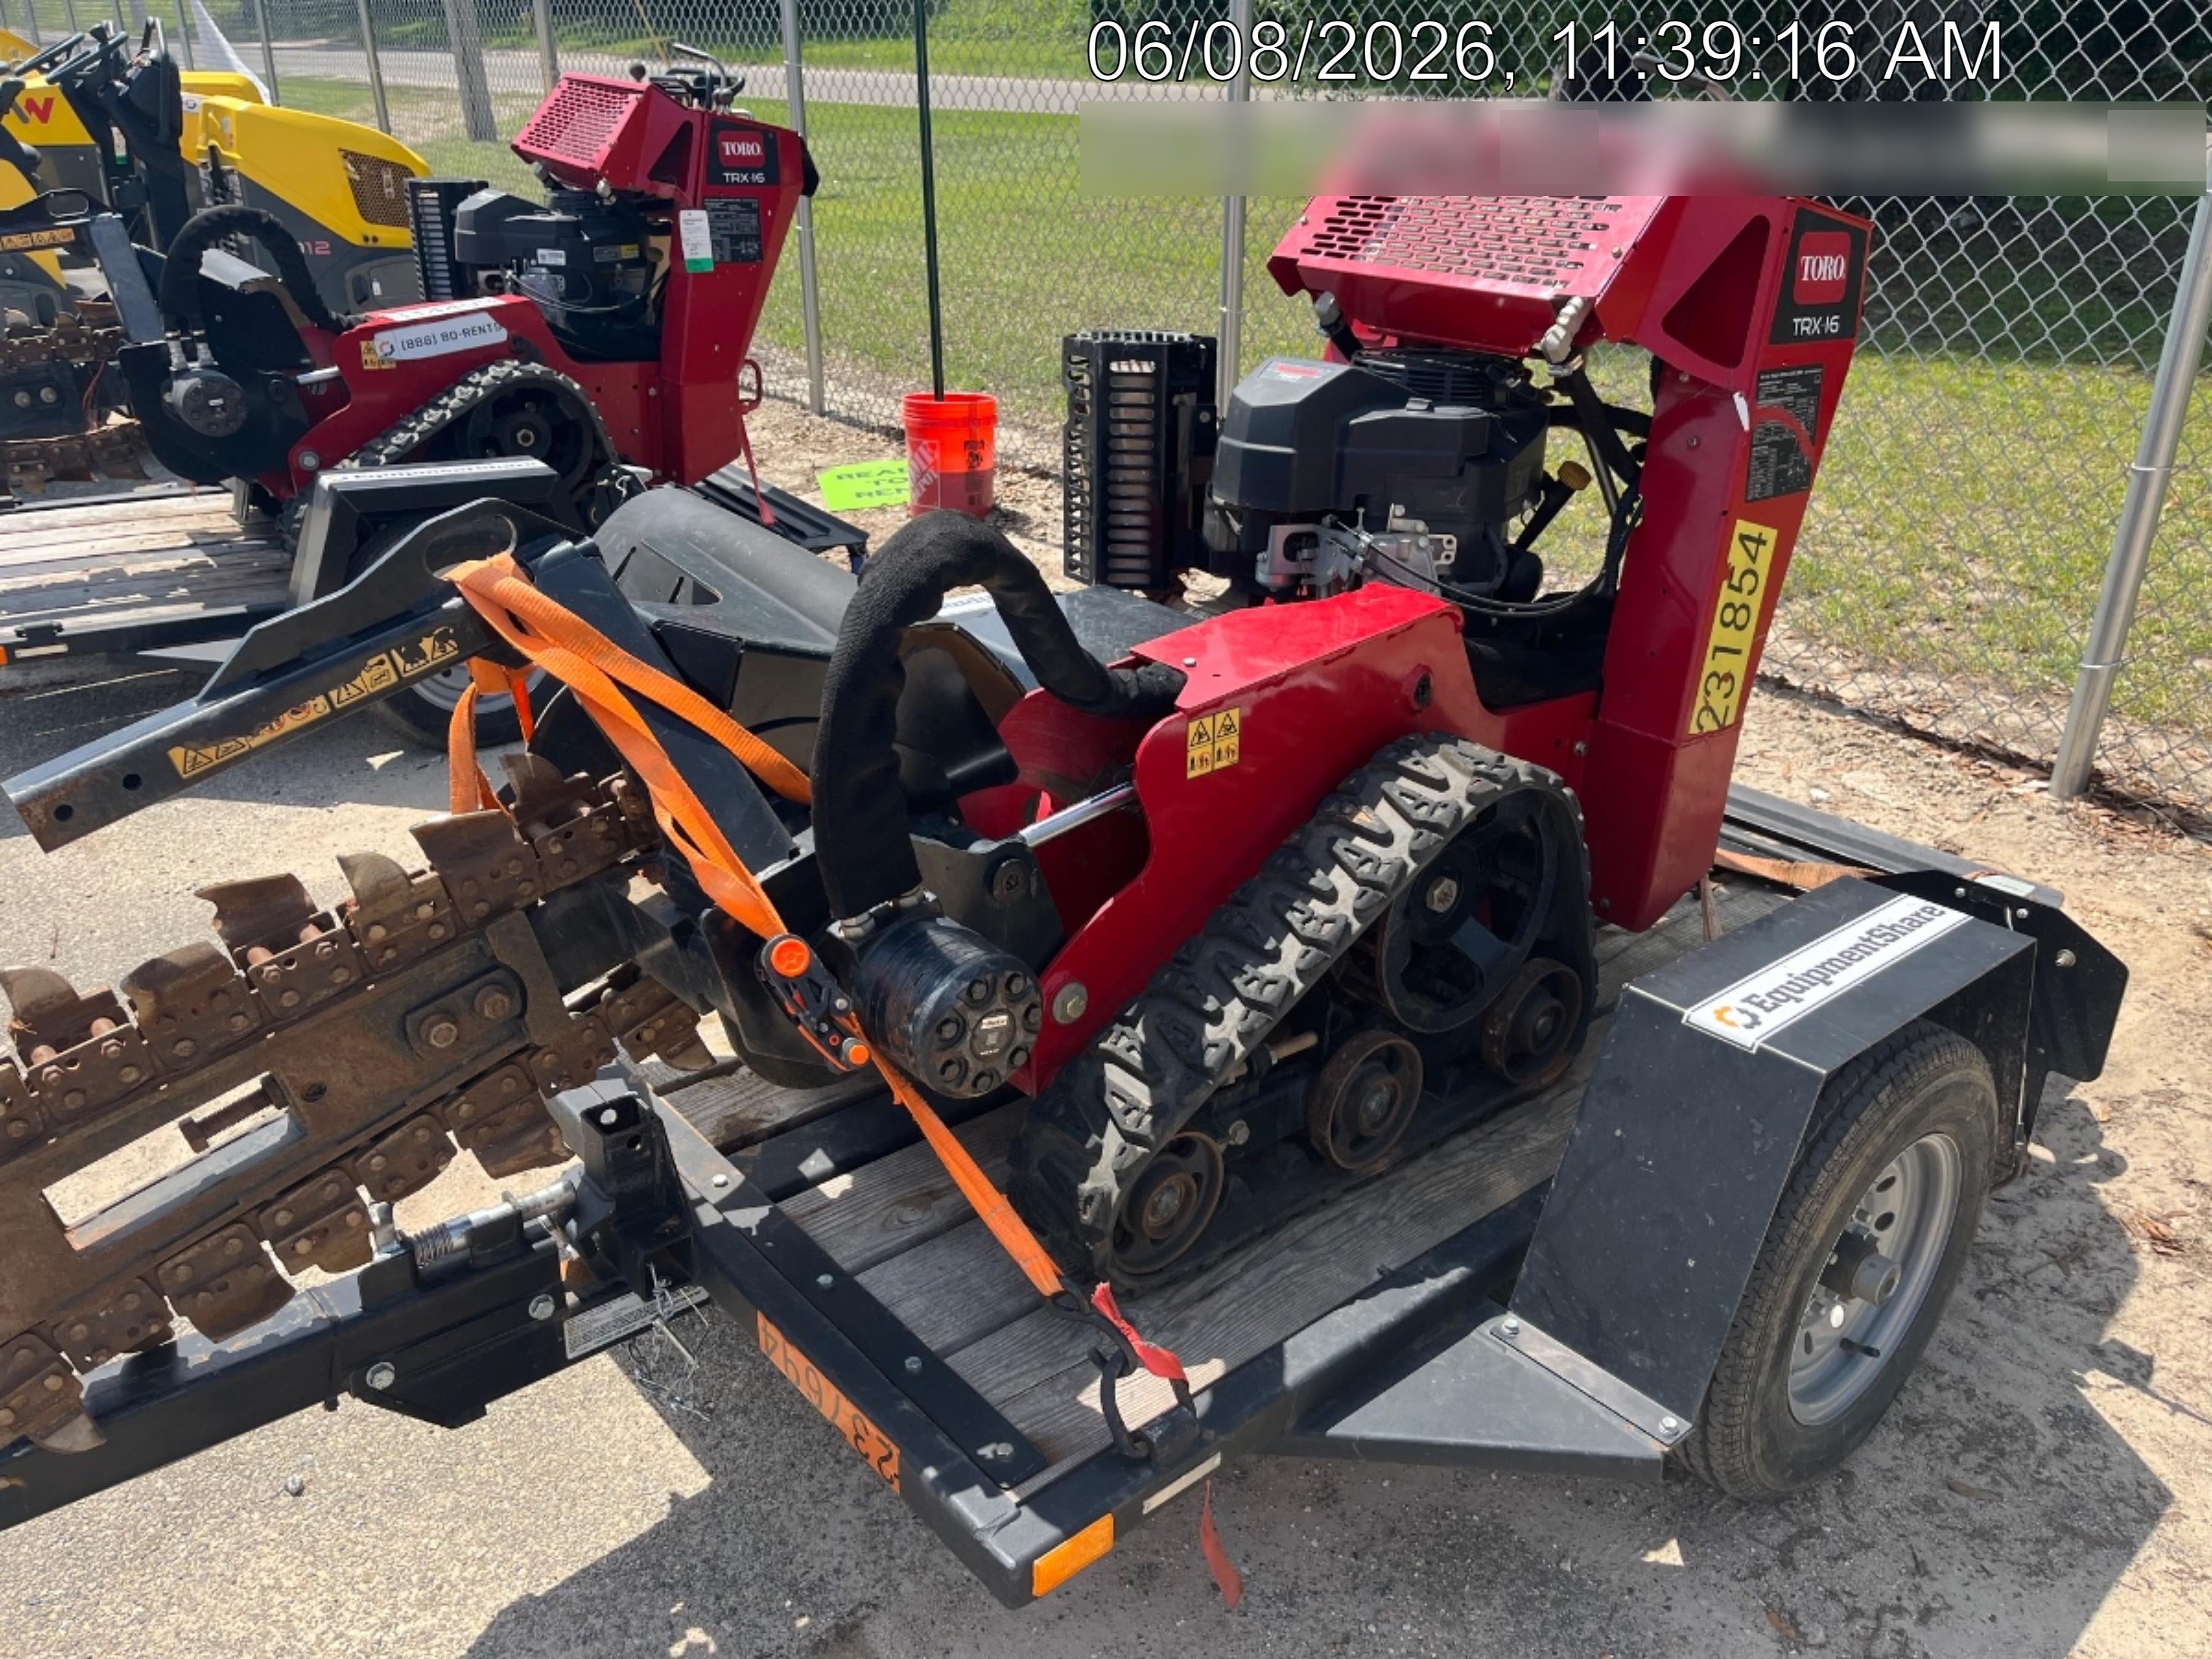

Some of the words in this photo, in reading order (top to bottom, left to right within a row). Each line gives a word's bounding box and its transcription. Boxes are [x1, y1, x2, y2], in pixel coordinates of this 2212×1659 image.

[722, 141, 761, 156] TORO
[722, 172, 766, 184] TRX-16
[1800, 254, 1846, 281] TORO
[1792, 314, 1840, 336] TRX-16
[1694, 531, 1768, 732] 231854
[1741, 904, 1946, 1014] EquipmentShare
